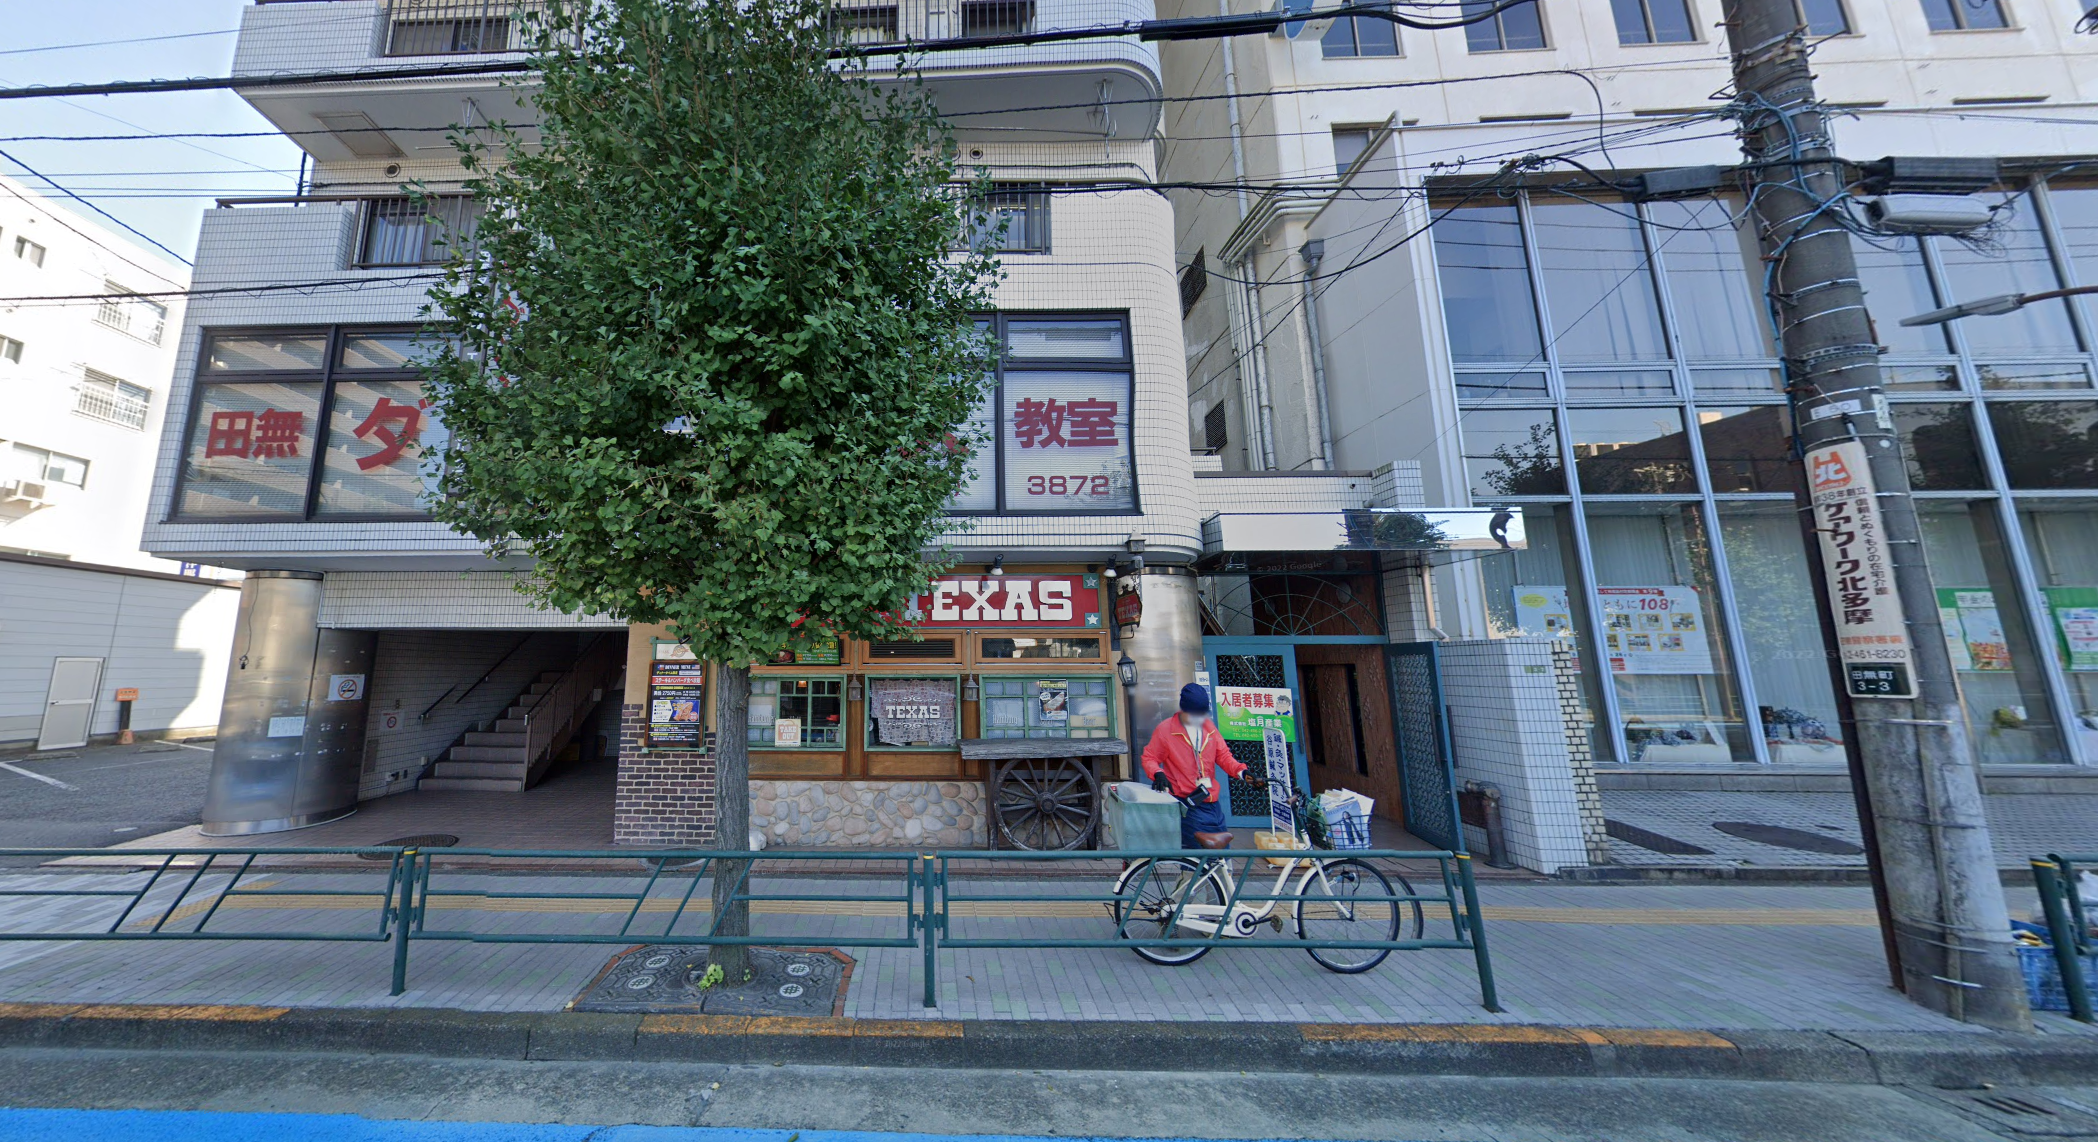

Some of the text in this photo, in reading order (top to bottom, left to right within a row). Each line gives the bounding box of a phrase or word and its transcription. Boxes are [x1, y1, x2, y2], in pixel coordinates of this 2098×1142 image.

[205, 408, 303, 459] 田無
[1014, 398, 1119, 449] 教室
[1027, 475, 1110, 495] 3872
[1852, 670, 1894, 680] 田無町
[1221, 692, 1275, 708] 入居者募集
[885, 705, 941, 719] TEXAS
